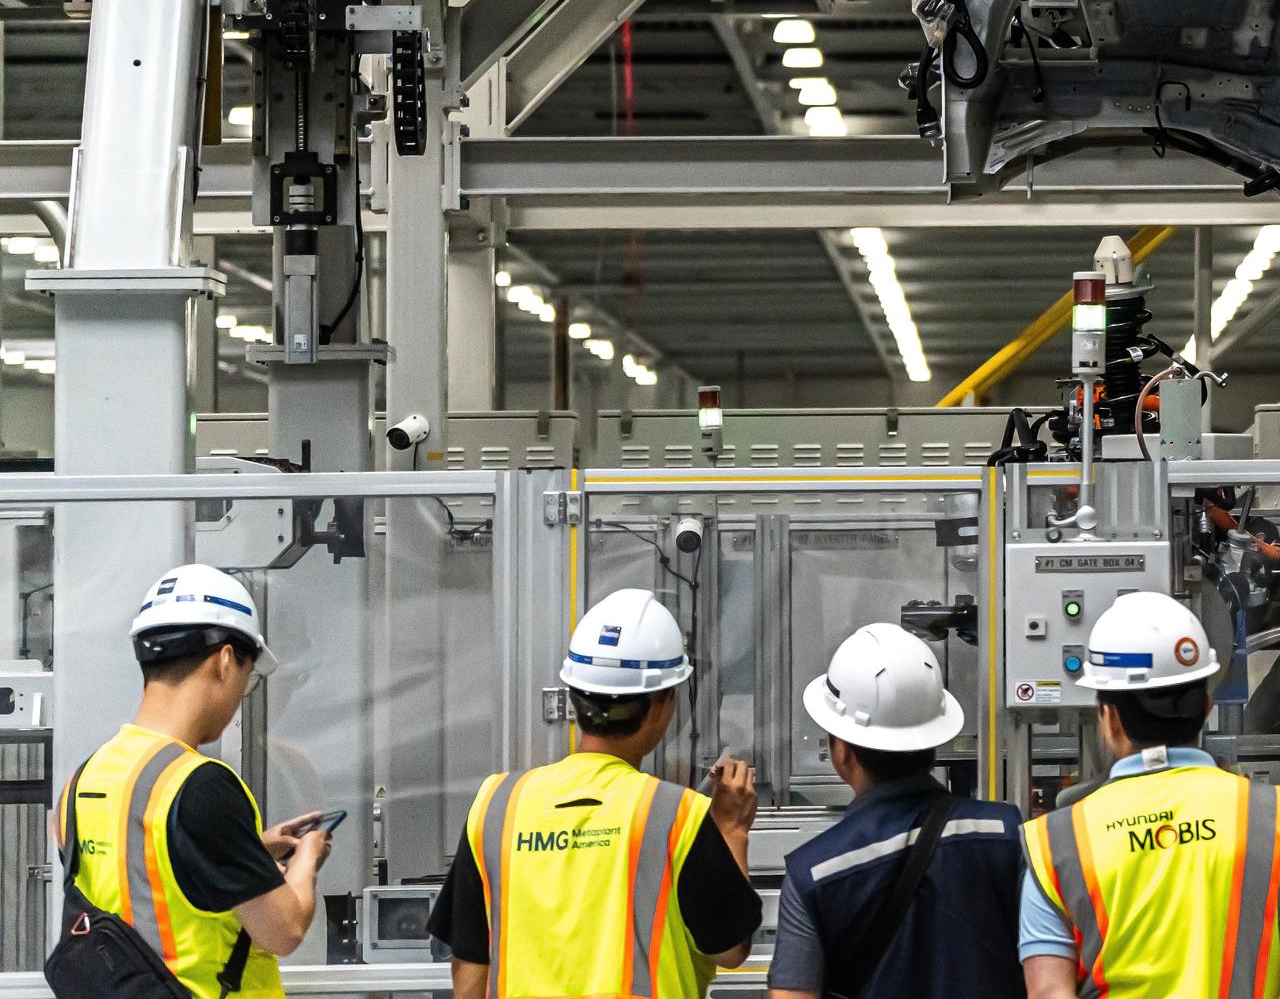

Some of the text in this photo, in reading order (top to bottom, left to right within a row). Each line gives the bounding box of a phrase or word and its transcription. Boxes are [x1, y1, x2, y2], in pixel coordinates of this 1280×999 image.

[1060, 559, 1073, 567] CM
[1077, 558, 1098, 567] GATE
[1103, 558, 1121, 567] BOX
[1124, 558, 1135, 567] 04
[1106, 810, 1174, 831] HYUNDAI
[571, 827, 621, 838] Metaplant
[1128, 818, 1217, 852] MOBIS
[80, 839, 96, 855] MG
[517, 830, 569, 852] HMG
[571, 839, 611, 850] America
